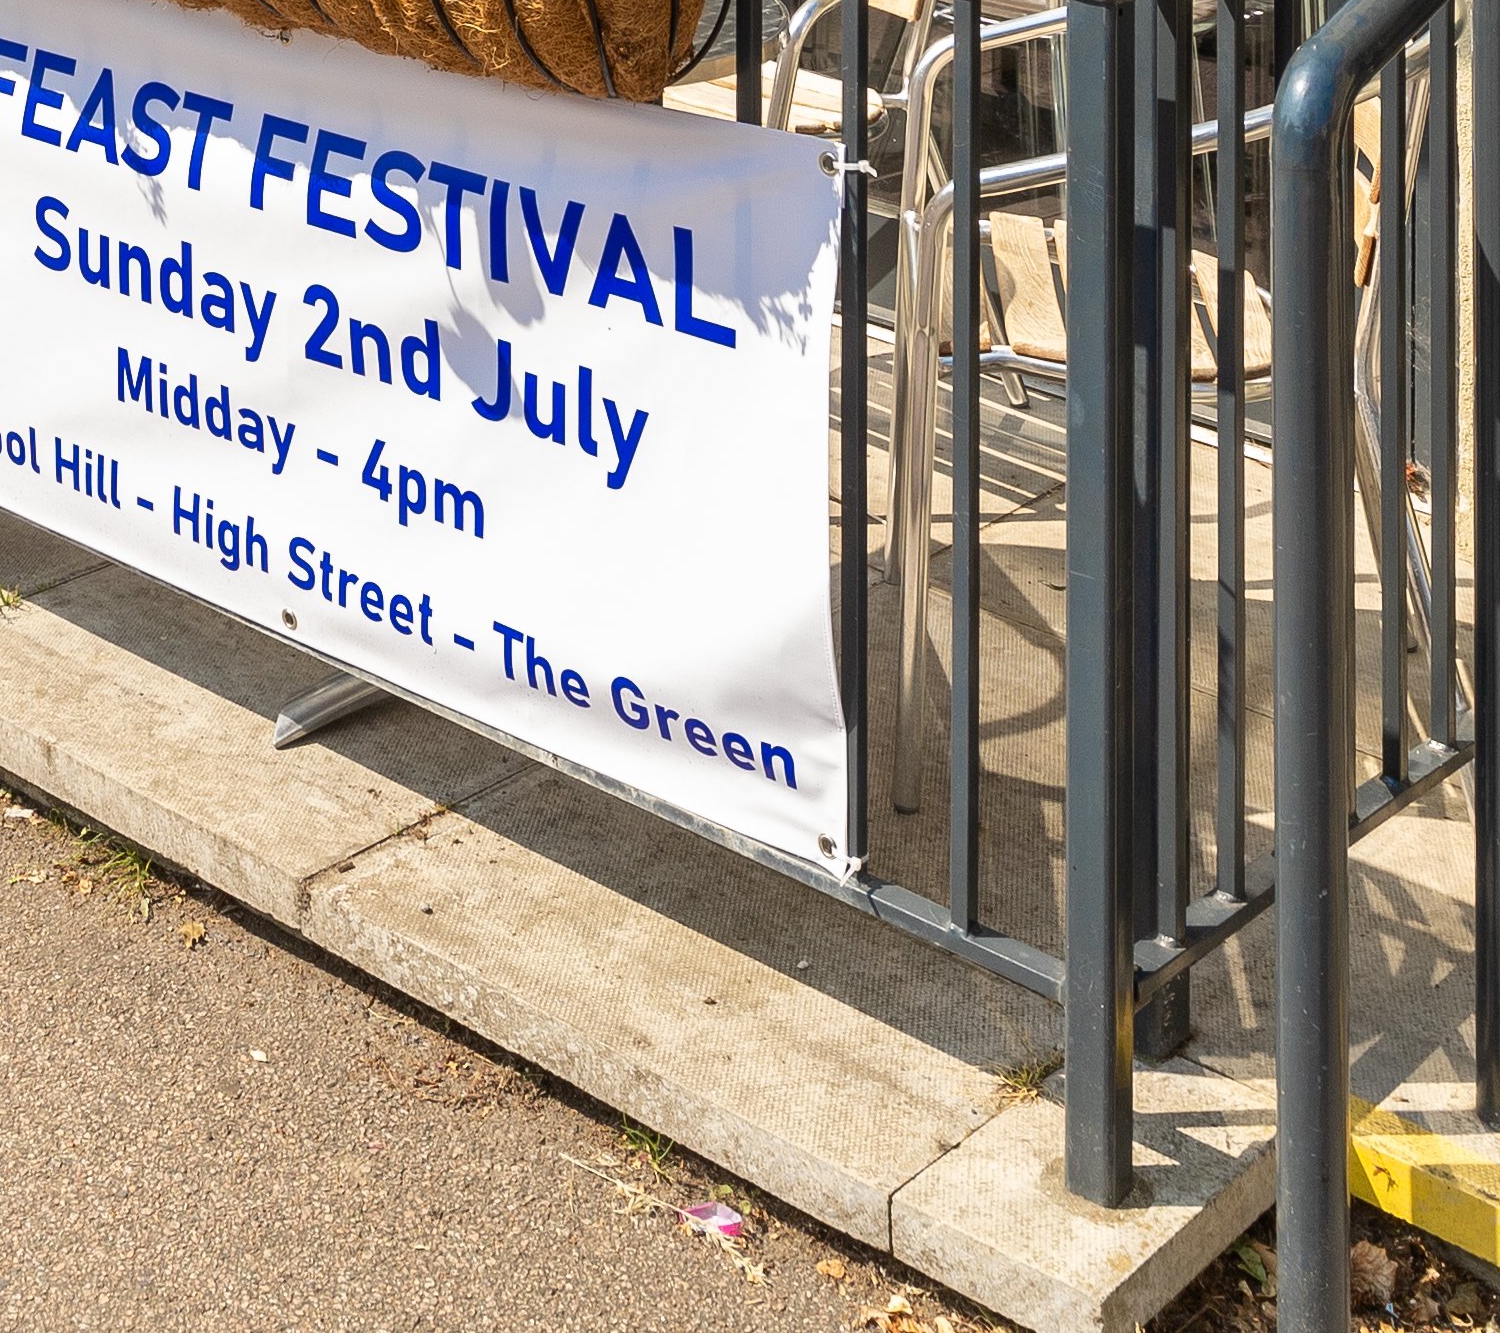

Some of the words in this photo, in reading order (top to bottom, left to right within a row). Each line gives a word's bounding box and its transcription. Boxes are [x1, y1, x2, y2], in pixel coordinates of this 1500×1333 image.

[33, 195, 278, 363] Sunday
[302, 283, 442, 402] 2nd
[470, 338, 650, 491] July
[249, 112, 737, 350] FESTIVAL
[116, 346, 296, 476] Midday
[361, 438, 485, 539] 4pm
[54, 435, 121, 509] Hill
[172, 484, 269, 573] High
[286, 535, 434, 646] Street
[492, 620, 590, 706] The
[610, 675, 798, 789] Green
